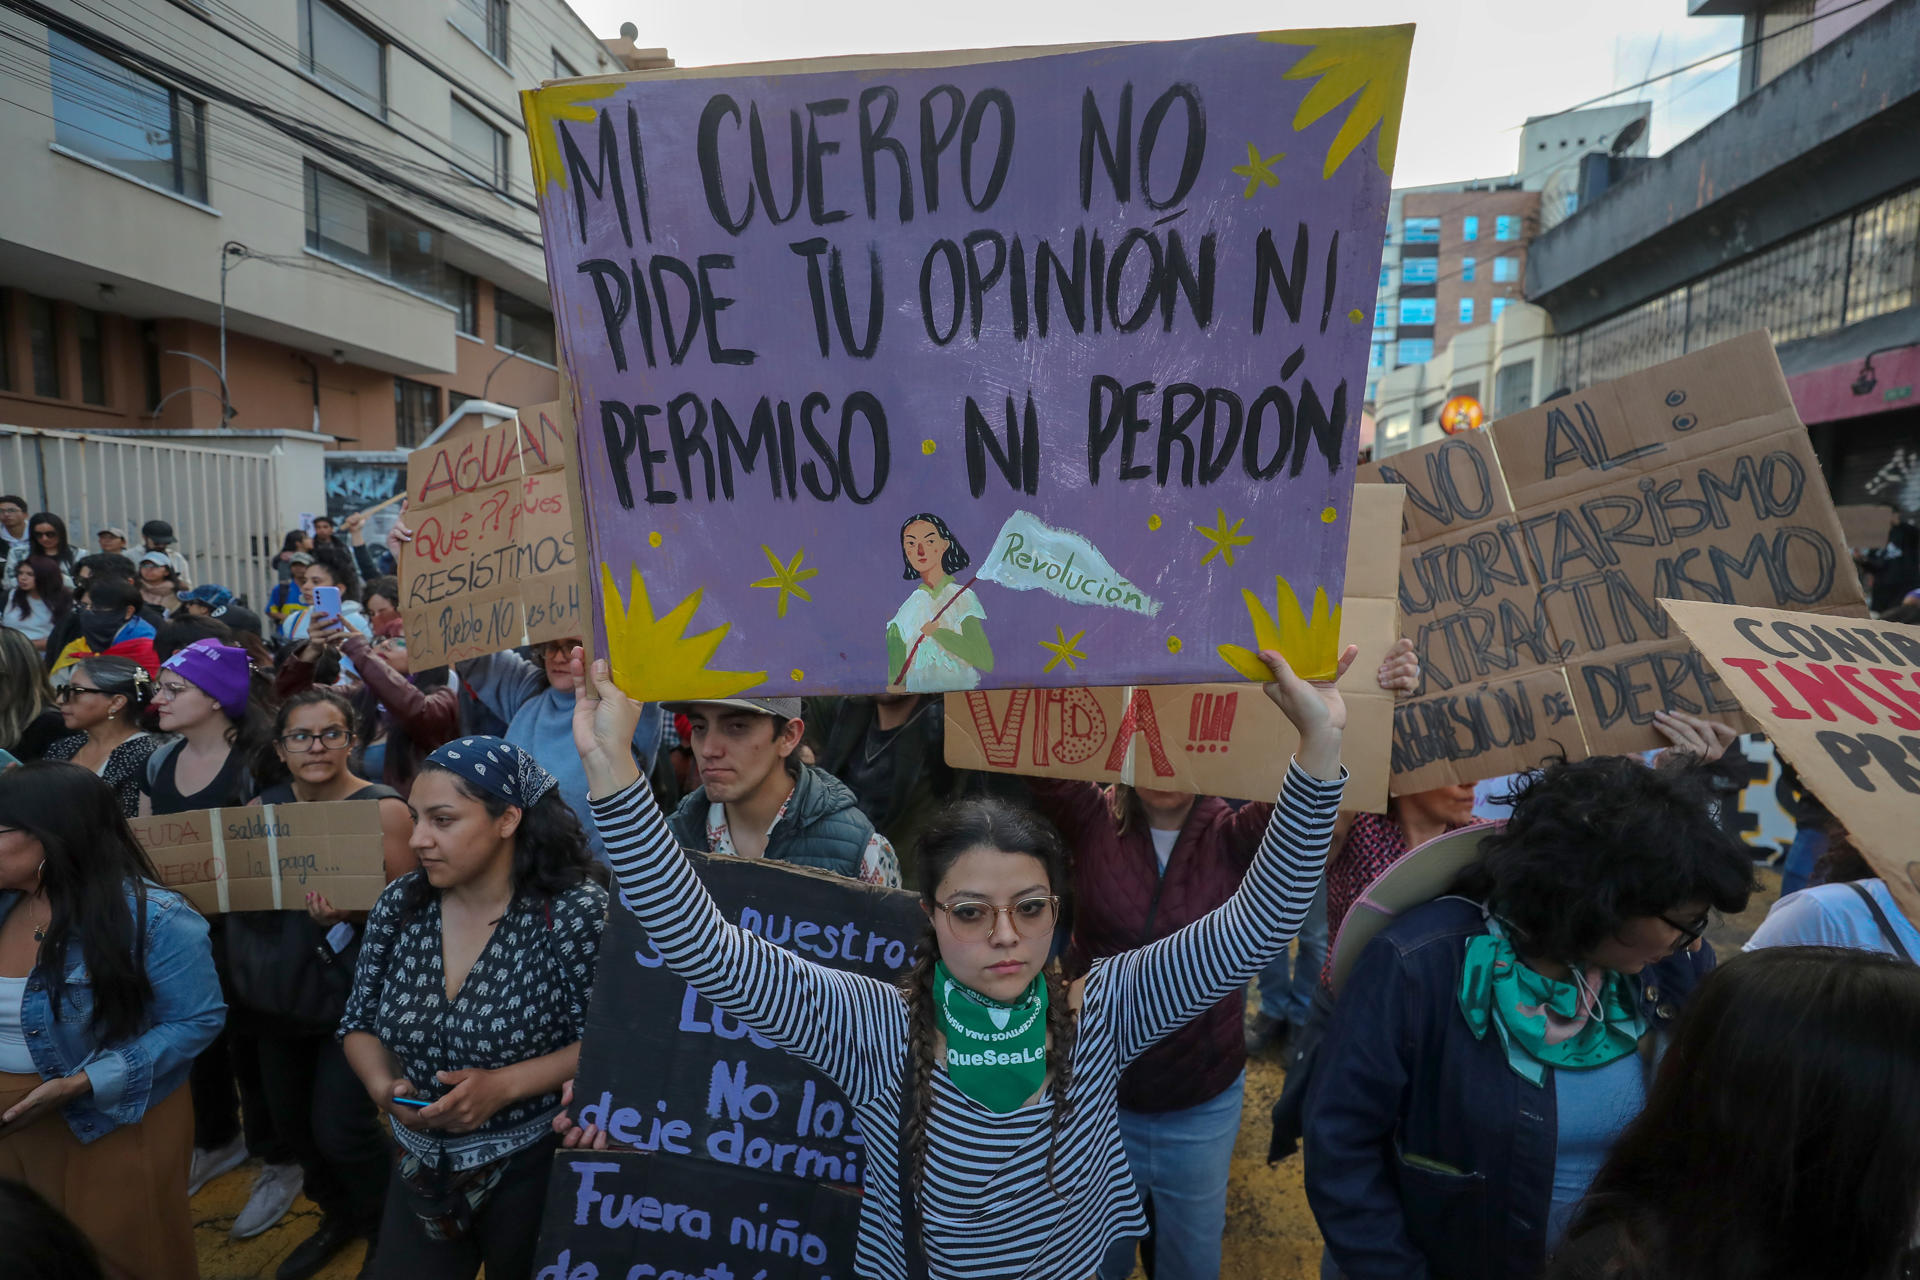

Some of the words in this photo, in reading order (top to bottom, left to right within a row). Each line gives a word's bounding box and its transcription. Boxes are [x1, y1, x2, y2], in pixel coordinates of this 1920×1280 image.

[558, 99, 652, 249] MI
[697, 84, 1016, 236] CUERPO
[1079, 80, 1207, 212] NO
[577, 254, 760, 374] PIDE
[789, 237, 884, 360] TU
[919, 209, 1216, 346] OPINIÓN
[1252, 222, 1339, 336] NI
[599, 390, 891, 510] PERMISO
[964, 389, 1040, 499] NI
[1087, 345, 1348, 488] PERDÓN
[1380, 439, 1494, 536] NO
[1001, 532, 1142, 610] Revolución
[964, 687, 1175, 777] VIDA
[133, 820, 200, 848] EUDA
[228, 814, 291, 840] saldada
[160, 857, 225, 886] EBLO
[739, 906, 918, 969] nuestro
[946, 1046, 1046, 1067] QueSeaLe
[965, 1027, 990, 1042] PARA
[706, 1060, 779, 1121] No
[579, 1091, 692, 1155] deje
[706, 1122, 867, 1187] dormi
[569, 1161, 711, 1240] Fuera
[729, 1202, 828, 1265] niño
